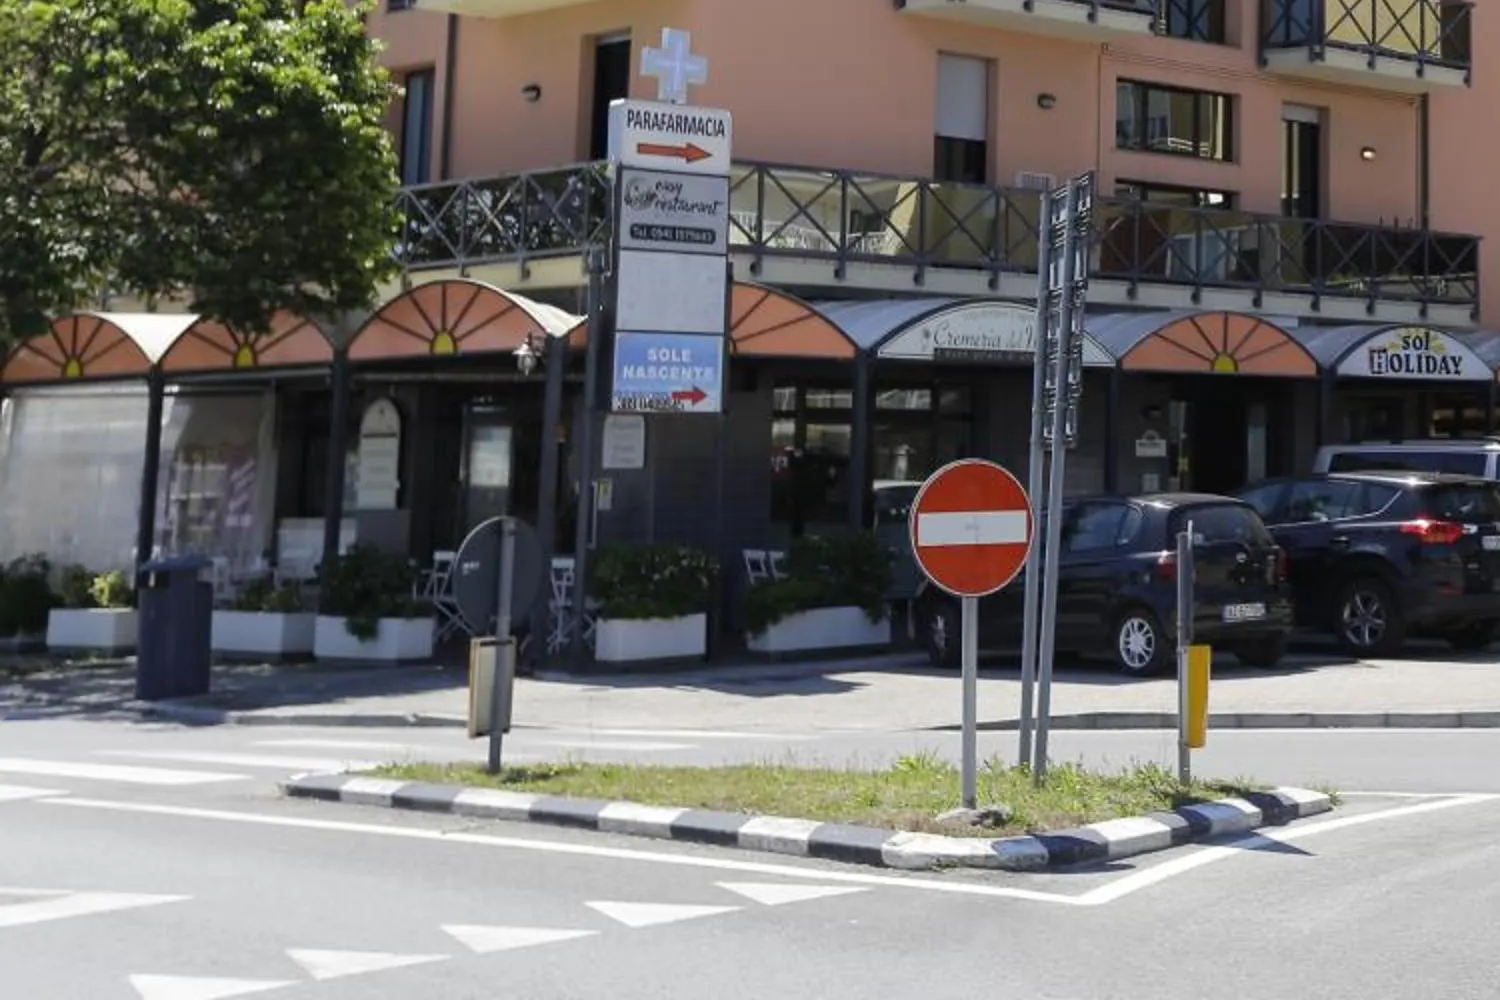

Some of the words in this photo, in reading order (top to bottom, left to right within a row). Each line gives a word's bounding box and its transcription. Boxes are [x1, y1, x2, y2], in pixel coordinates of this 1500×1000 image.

[626, 108, 726, 137] PARAFARMACIA
[1402, 331, 1430, 351] sol
[647, 346, 691, 362] SOLE
[1369, 347, 1463, 376] HOLIDAY
[623, 364, 716, 381] NASCENTE
